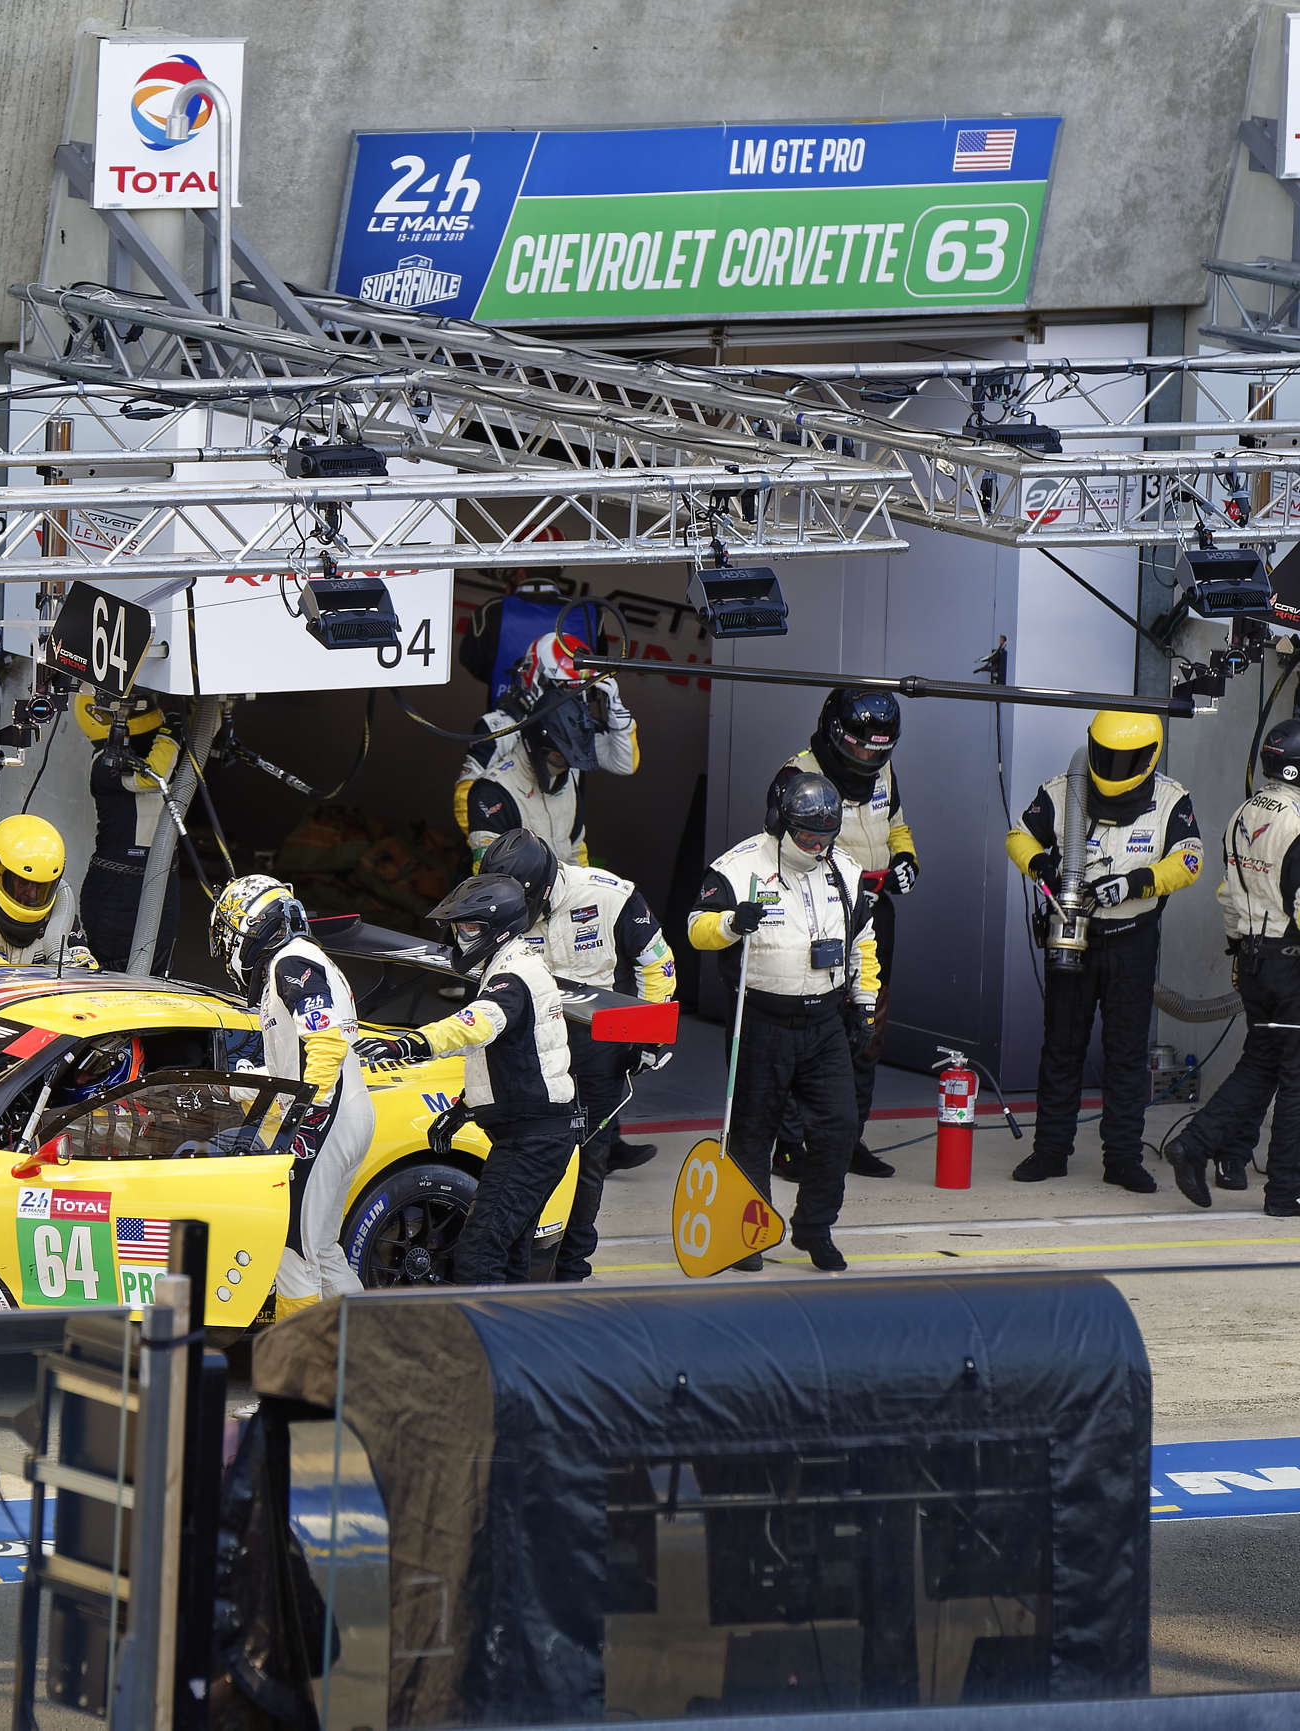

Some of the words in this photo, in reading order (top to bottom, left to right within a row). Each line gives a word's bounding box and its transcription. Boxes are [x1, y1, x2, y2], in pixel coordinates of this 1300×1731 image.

[729, 139, 767, 175] LM
[771, 139, 815, 174] GTE
[819, 137, 865, 173] PRO
[109, 165, 219, 193] TOTAL
[374, 153, 481, 214] 24h
[367, 216, 399, 232] LE
[399, 215, 470, 231] MANS
[397, 233, 421, 242] 15-16
[422, 232, 441, 242] JUIN
[443, 232, 465, 241] 2019
[505, 229, 716, 295] CHEVROLET
[717, 223, 905, 287] CORVETTE
[925, 217, 1010, 283] 63
[362, 269, 460, 306] SUPERFINALE
[75, 525, 93, 540] LE
[92, 595, 128, 692] 64
[60, 648, 88, 665] CORVETTE
[60, 655, 87, 673] RACING
[1126, 845, 1147, 853] Mobil
[574, 940, 597, 952] Mobil
[304, 994, 325, 1009] 24h
[21, 1191, 49, 1209] 24h
[54, 1197, 108, 1214] TOTAL
[678, 1157, 718, 1258] 63
[33, 1224, 100, 1300] 64
